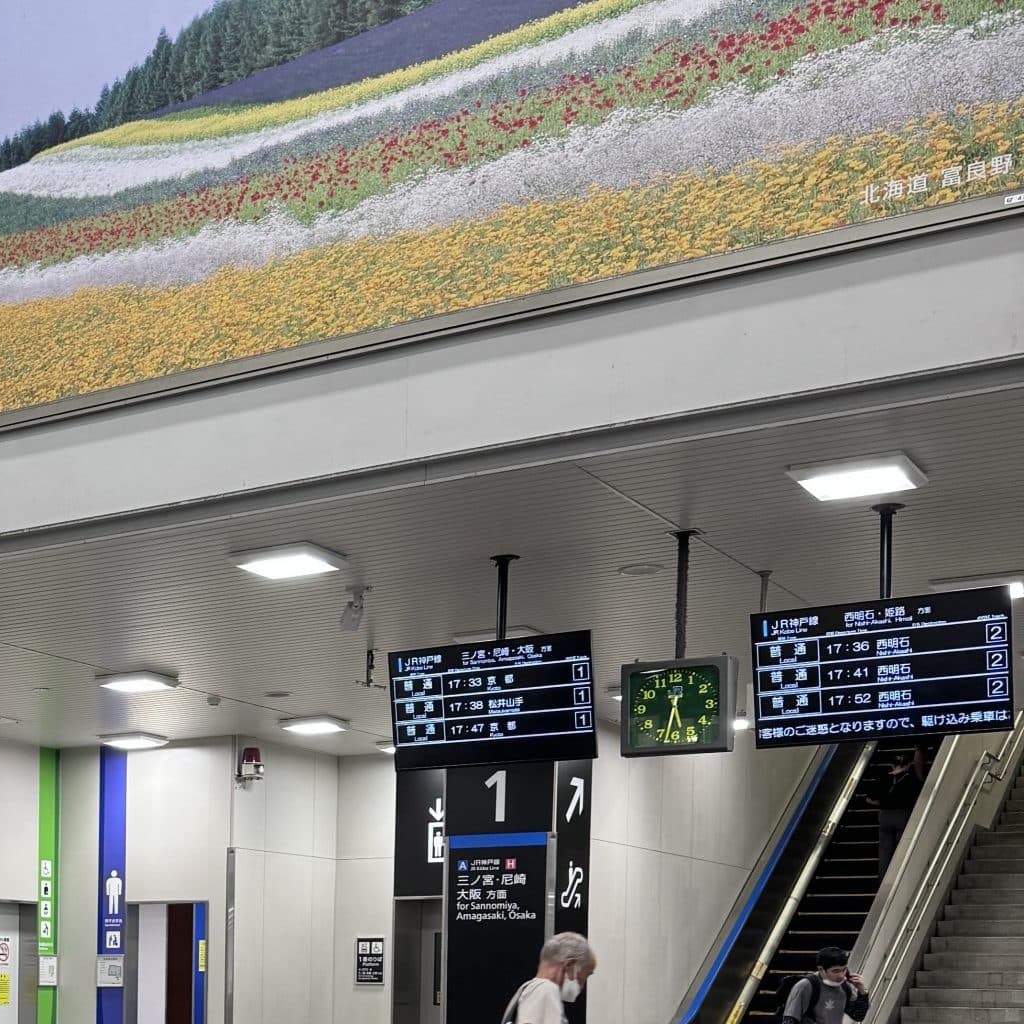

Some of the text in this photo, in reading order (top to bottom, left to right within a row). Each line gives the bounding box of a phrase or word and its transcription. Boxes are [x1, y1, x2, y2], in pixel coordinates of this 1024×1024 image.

[859, 154, 1013, 205] 北海道 富良野
[844, 606, 906, 622] 西明石・姫路
[771, 616, 819, 630] JR神戸線
[990, 626, 1002, 640] 2
[827, 641, 870, 655] 17:36
[877, 636, 910, 650] 西明石
[991, 653, 1003, 667] 2
[577, 666, 583, 678] 1
[828, 667, 868, 681] 17:41
[877, 663, 911, 676] 西明石
[448, 677, 482, 689] 17:33
[654, 679, 666, 688] 11
[668, 673, 682, 683] 12
[688, 675, 694, 685] 1
[698, 684, 708, 694] 2
[992, 680, 1004, 694] 2
[579, 690, 585, 701] 1
[643, 690, 656, 700] 10
[829, 693, 872, 706] 17:52
[878, 689, 912, 703] 西明石
[449, 701, 484, 712] 17:38
[488, 696, 524, 709] 松井山手
[705, 699, 714, 709] 3
[637, 705, 646, 714] 9
[580, 715, 586, 726] 1
[644, 720, 653, 729] 8
[697, 715, 707, 725] 4
[759, 710, 1010, 739] 客様のご迷惑となりますので、駆け込み乗車は
[450, 723, 484, 735] 17:47
[656, 729, 665, 738] 7
[686, 726, 695, 736] 5
[671, 731, 680, 740] 6
[484, 770, 507, 822] 1
[458, 861, 468, 871] A
[507, 859, 516, 869] H
[456, 873, 526, 886] 三ノ宮・尼崎
[456, 888, 508, 900] 大阪 方面
[456, 901, 520, 912] for Sannomiya,
[456, 911, 507, 922] Amagasaki,
